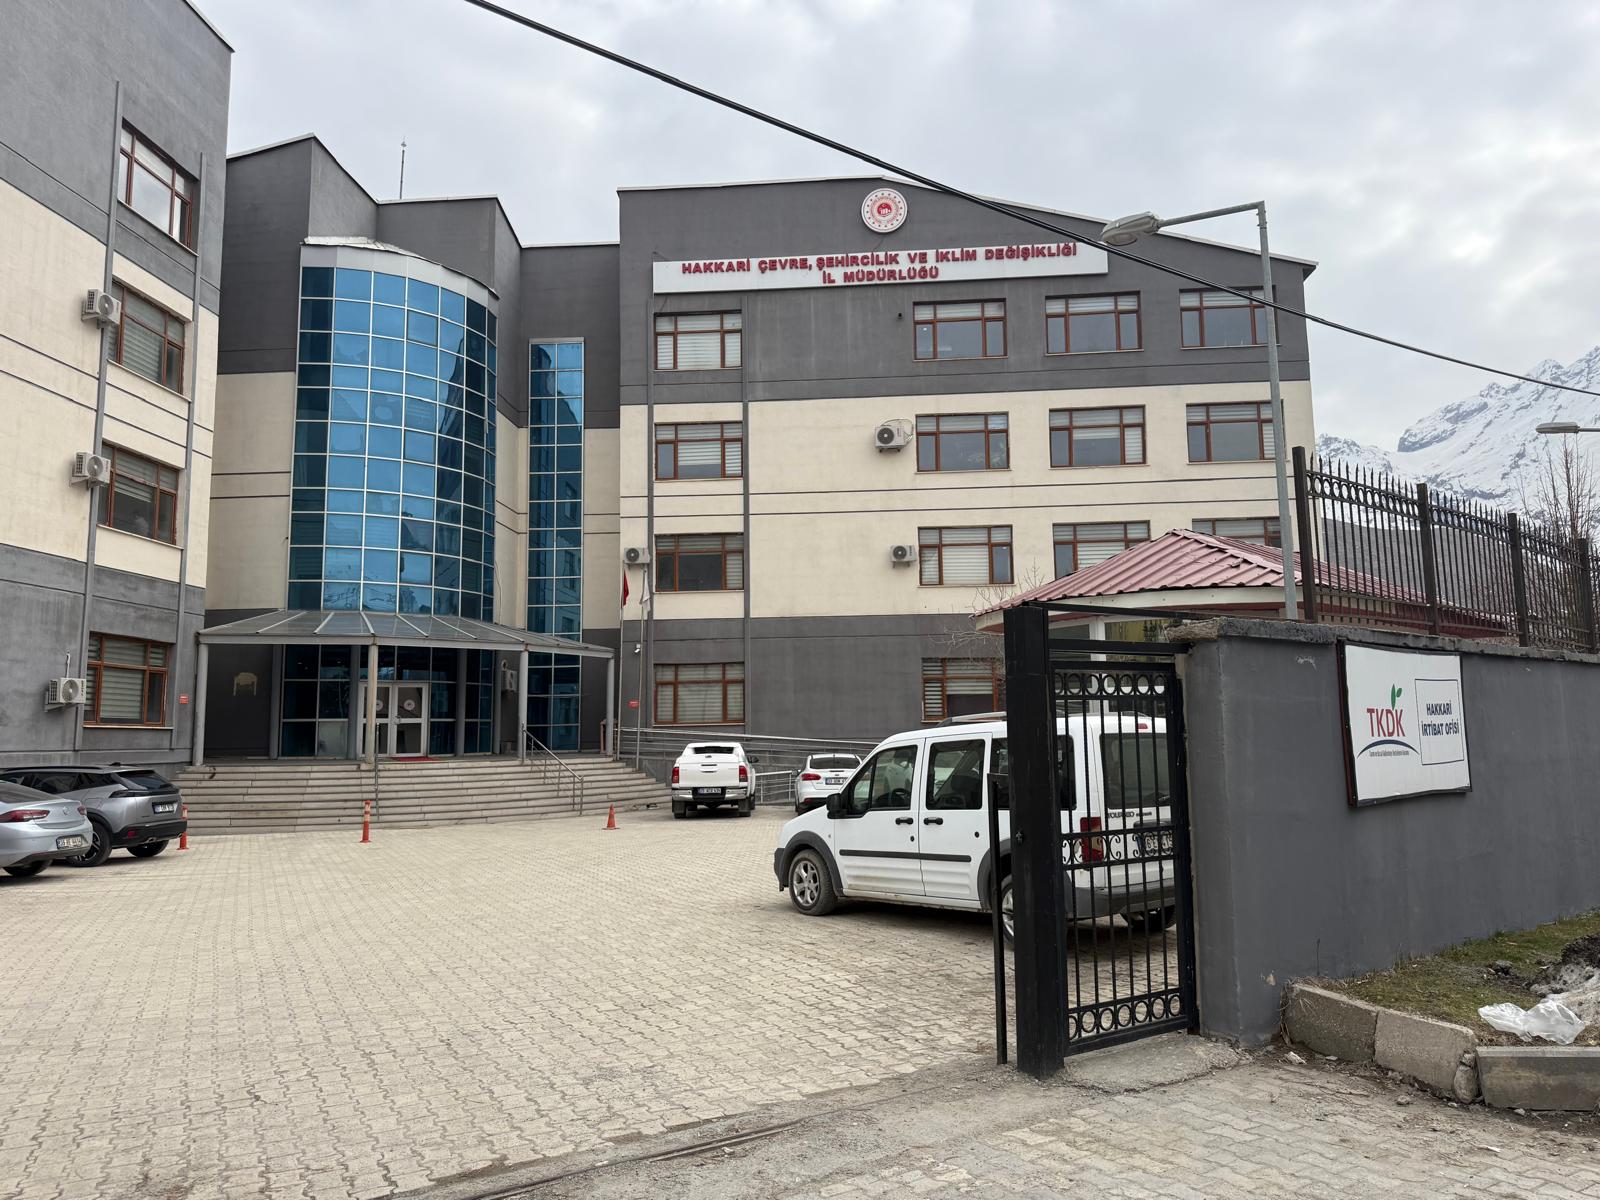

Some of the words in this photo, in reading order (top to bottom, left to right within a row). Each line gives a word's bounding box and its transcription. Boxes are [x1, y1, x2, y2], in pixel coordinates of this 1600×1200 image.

[682, 258, 751, 274] HAKKARİ
[758, 257, 813, 274] ÇEVRE,
[816, 252, 900, 271] ŞEHİRCİLİK
[907, 252, 928, 264] VE
[936, 247, 977, 263] İKLİM
[984, 242, 1077, 261] DEĞİŞİKLİĞİ
[822, 270, 836, 284] İL
[843, 266, 939, 284] MÜDÜRLÜĞÜ
[1426, 700, 1453, 716] HAKKARİ
[1366, 708, 1406, 738] TKDK
[1421, 720, 1444, 737] İRTİBAT
[1444, 718, 1460, 735] OFİSİ
